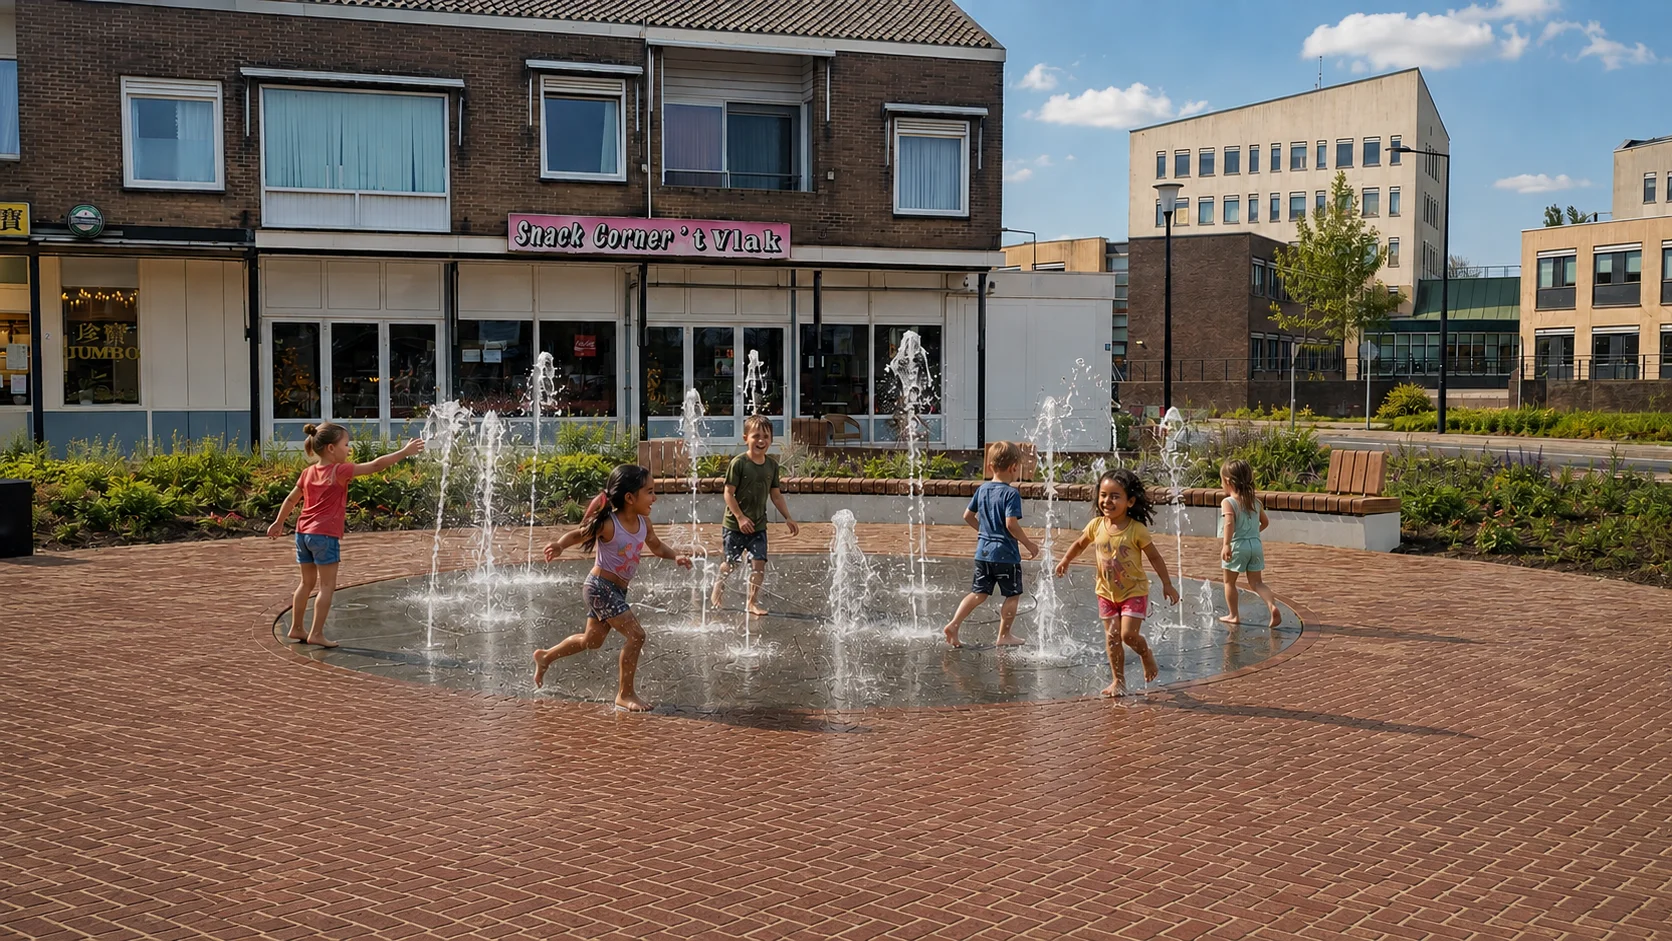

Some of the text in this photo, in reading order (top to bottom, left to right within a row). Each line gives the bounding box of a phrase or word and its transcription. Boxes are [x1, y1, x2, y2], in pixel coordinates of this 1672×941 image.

[515, 220, 585, 248] Snack
[592, 223, 675, 250] Corner
[711, 229, 783, 253] Vlak
[68, 346, 140, 360] JUMBO
